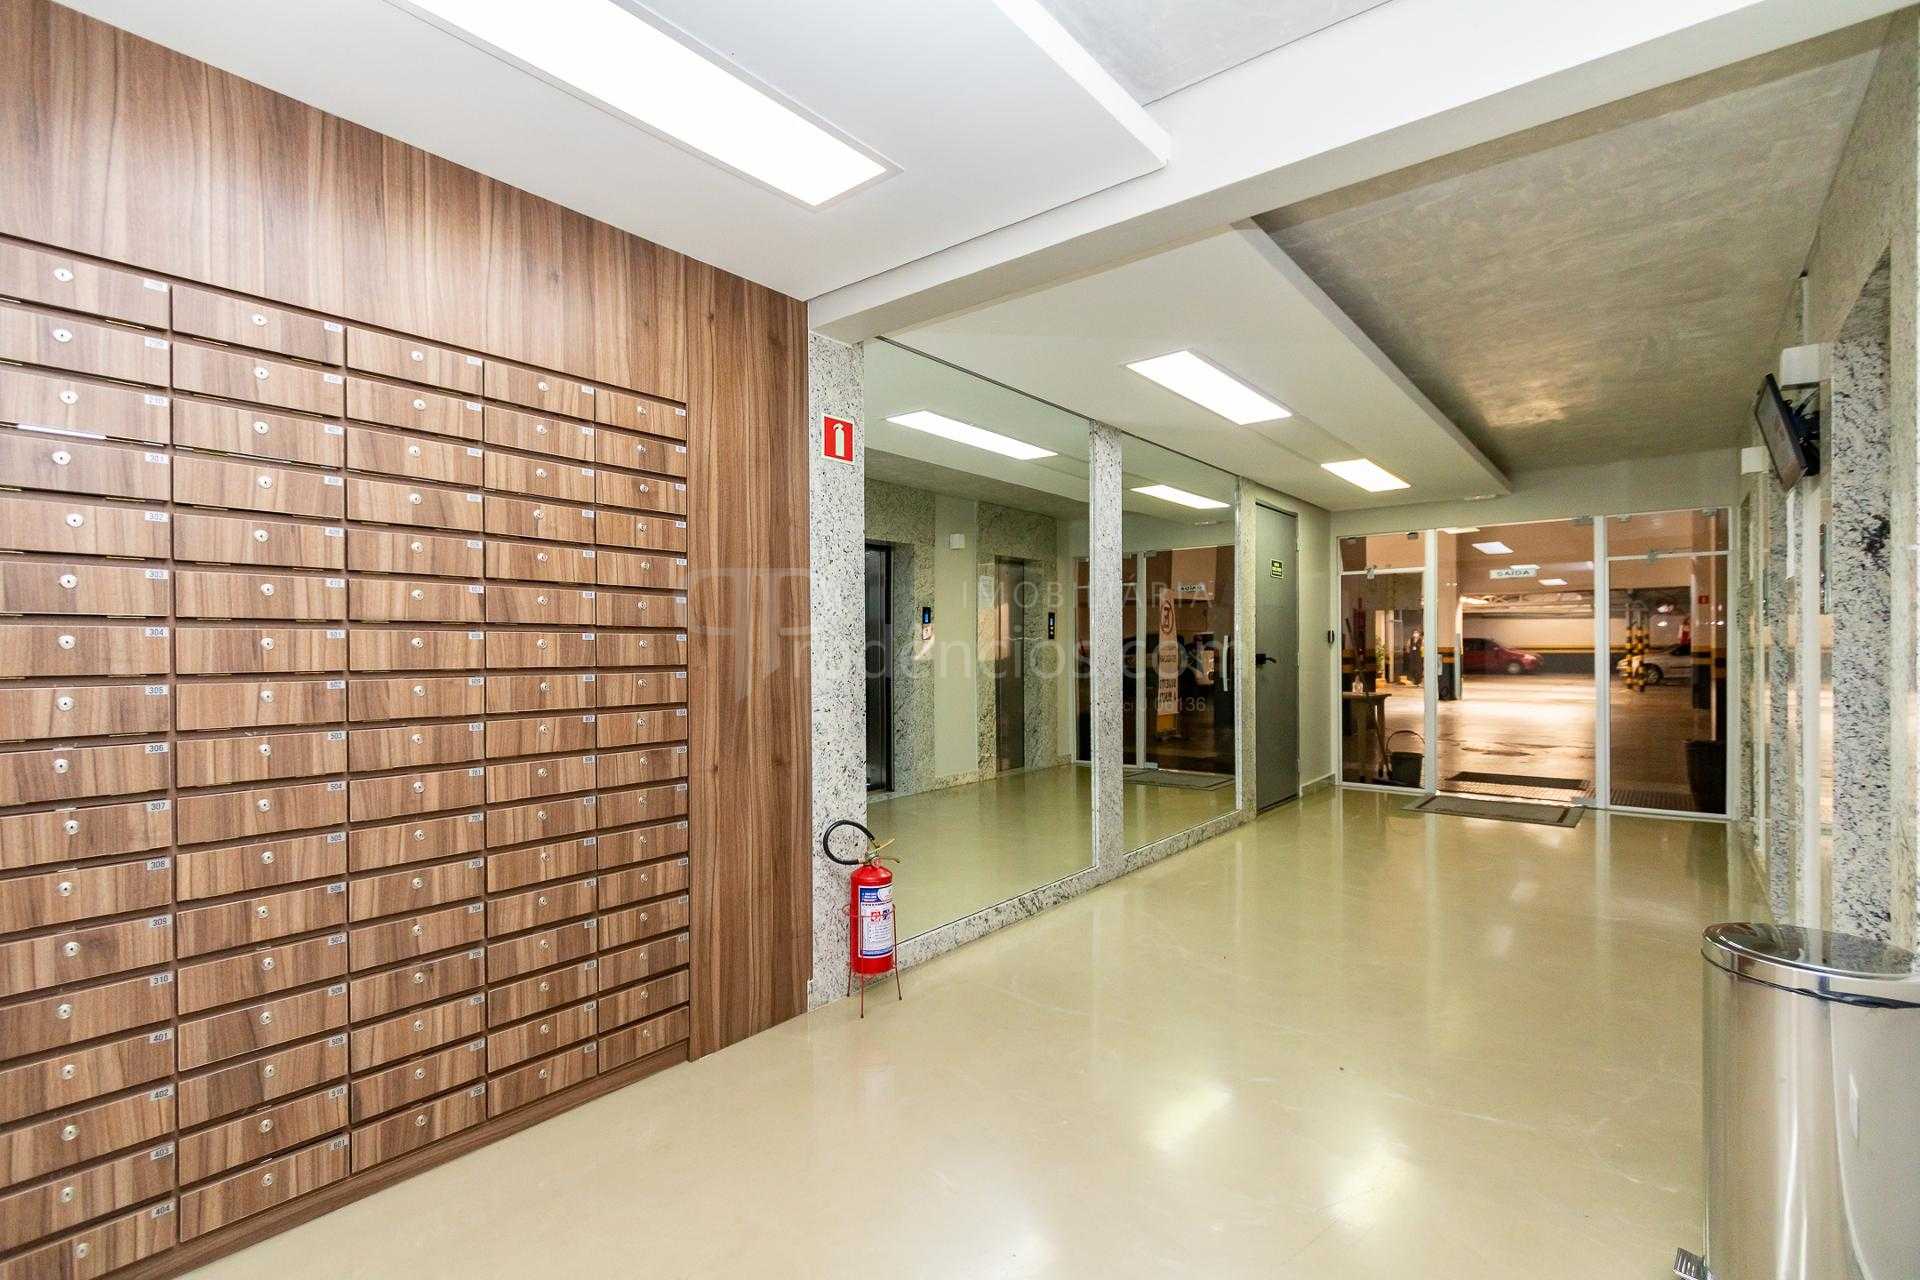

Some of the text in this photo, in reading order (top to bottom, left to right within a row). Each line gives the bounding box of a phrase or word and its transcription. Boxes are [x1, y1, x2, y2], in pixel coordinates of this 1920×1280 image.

[151, 802, 165, 810] 307
[151, 860, 165, 869] 308
[153, 975, 168, 985] 310
[154, 1032, 168, 1041] 401
[154, 1088, 169, 1098] 402
[155, 1205, 170, 1215] 404
